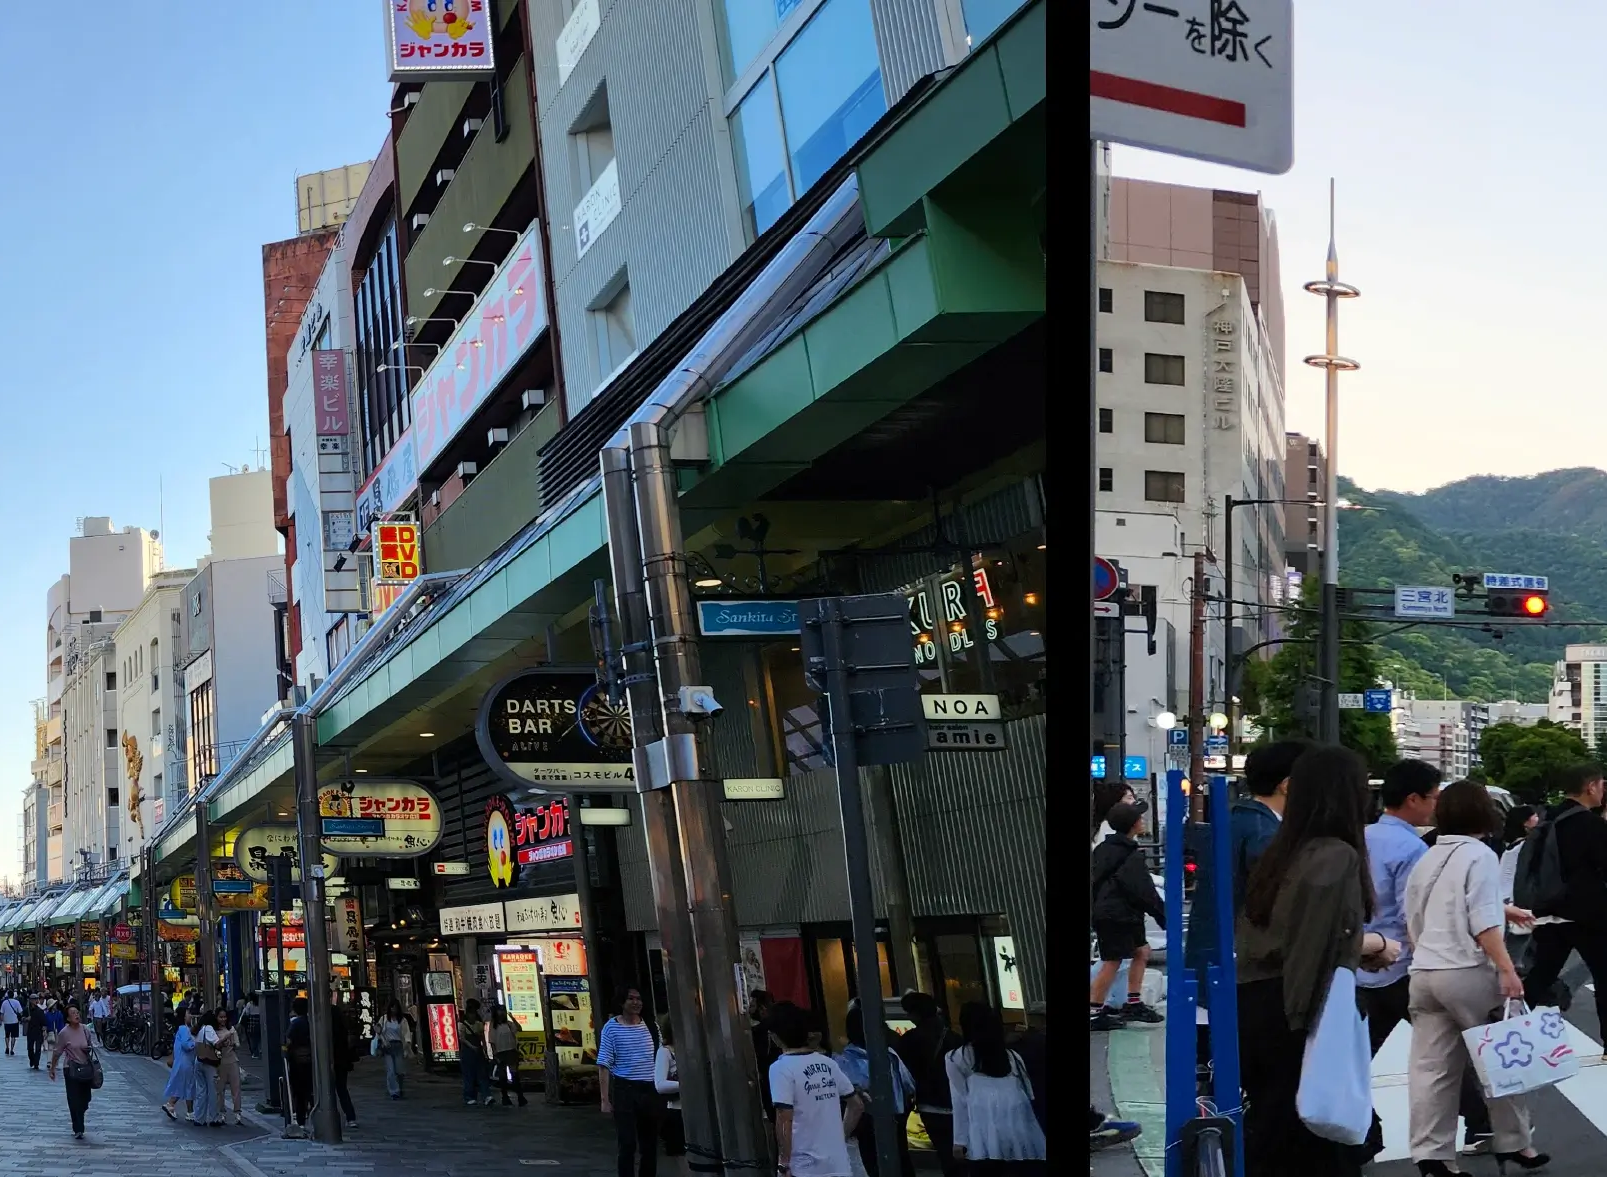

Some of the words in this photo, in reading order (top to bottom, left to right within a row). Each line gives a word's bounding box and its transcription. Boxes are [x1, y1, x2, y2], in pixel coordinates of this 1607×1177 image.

[400, 42, 485, 59] ジャンカラ
[414, 243, 537, 461] ジャンカラ
[319, 353, 343, 432] 幸楽ビル
[399, 525, 419, 579] DVD
[1400, 590, 1449, 603] 三宮北
[715, 609, 774, 624] Sankita
[507, 699, 577, 714] DARTS
[934, 700, 989, 715] NOA
[508, 718, 552, 734] BAR
[936, 729, 997, 744] amie
[1173, 731, 1185, 743] P
[573, 771, 623, 779] コスモビル
[359, 796, 430, 812] ジャンカラ
